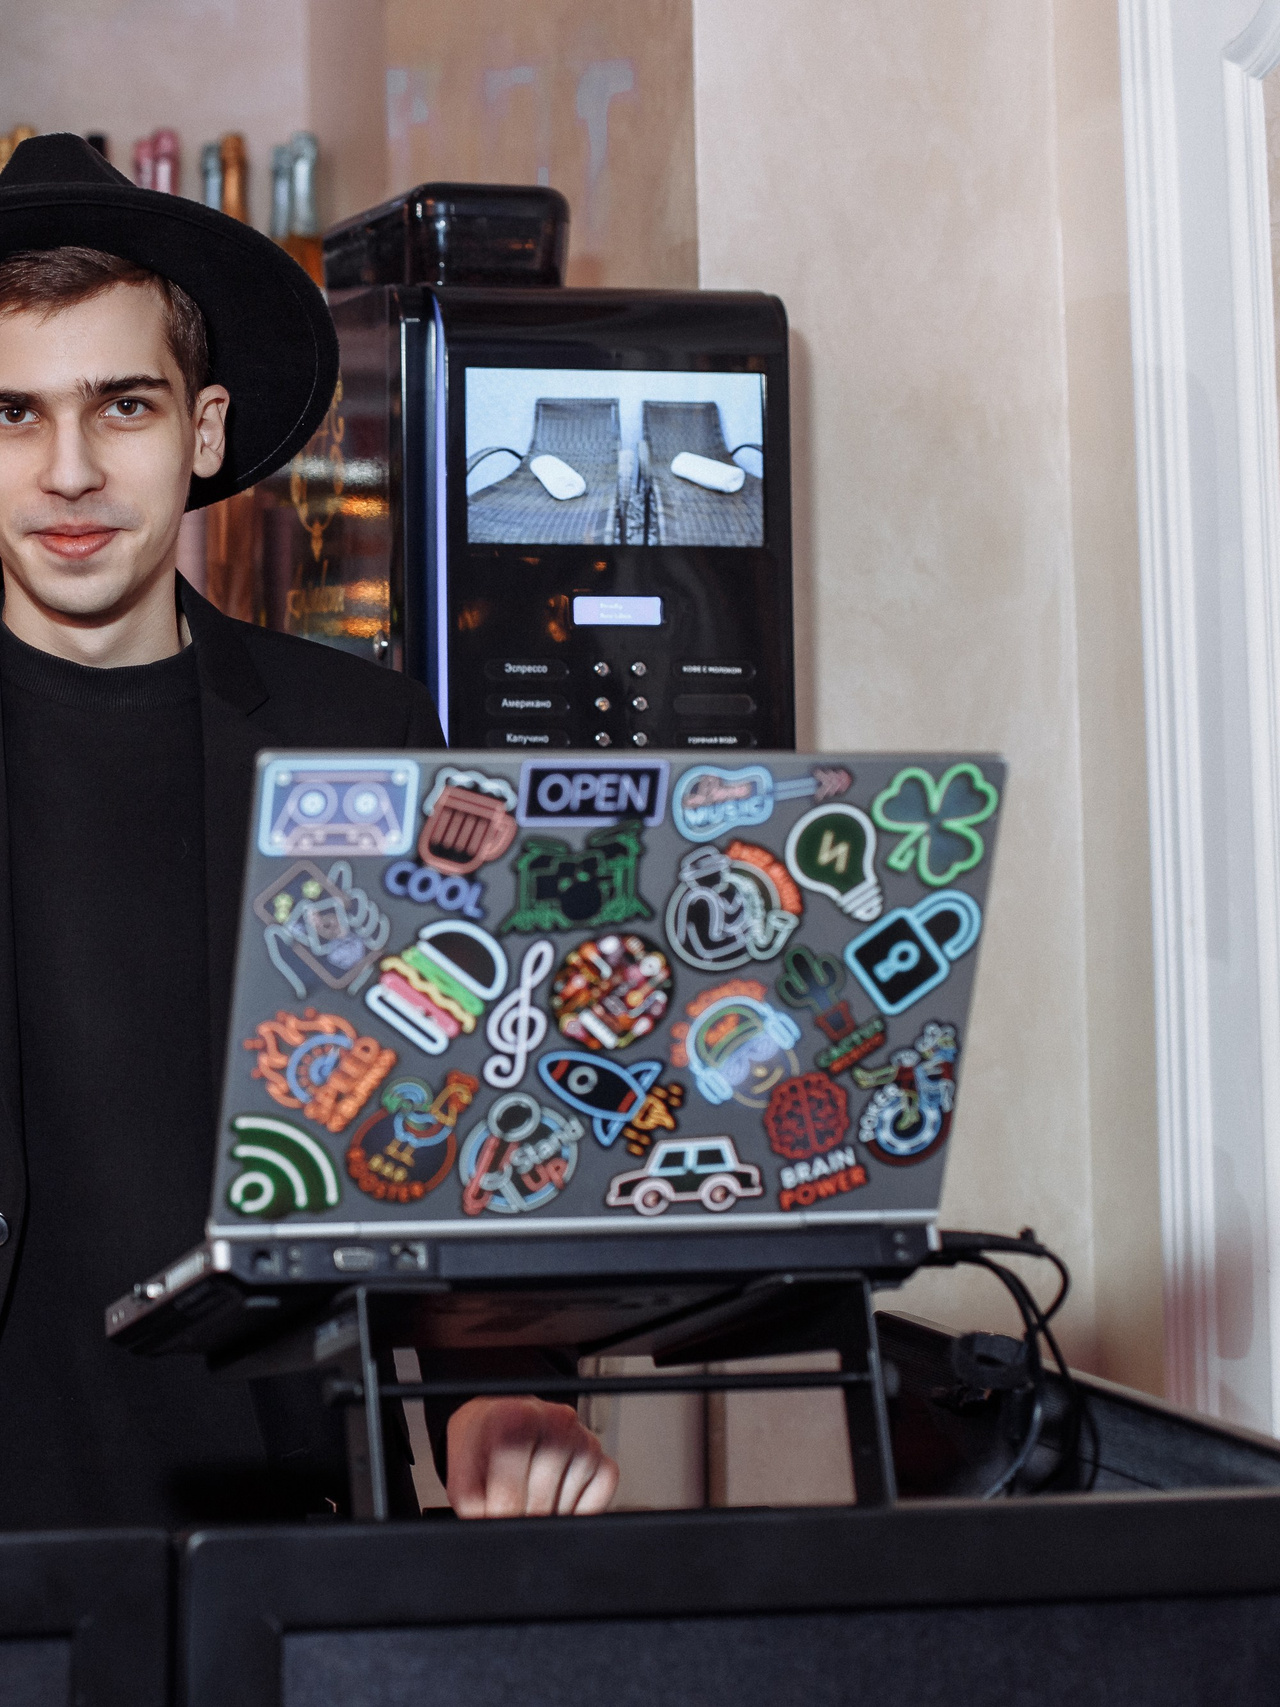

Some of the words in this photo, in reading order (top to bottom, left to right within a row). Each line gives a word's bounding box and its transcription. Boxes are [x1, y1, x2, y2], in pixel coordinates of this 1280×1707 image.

[505, 663, 548, 675] Эспрессо
[502, 698, 552, 710] Американо
[506, 733, 549, 745] Капучино
[537, 773, 650, 812] OPEN
[385, 860, 484, 919] COOL
[521, 1157, 568, 1190] UP
[780, 1146, 856, 1190] BRAIN
[779, 1166, 867, 1212] POWER
